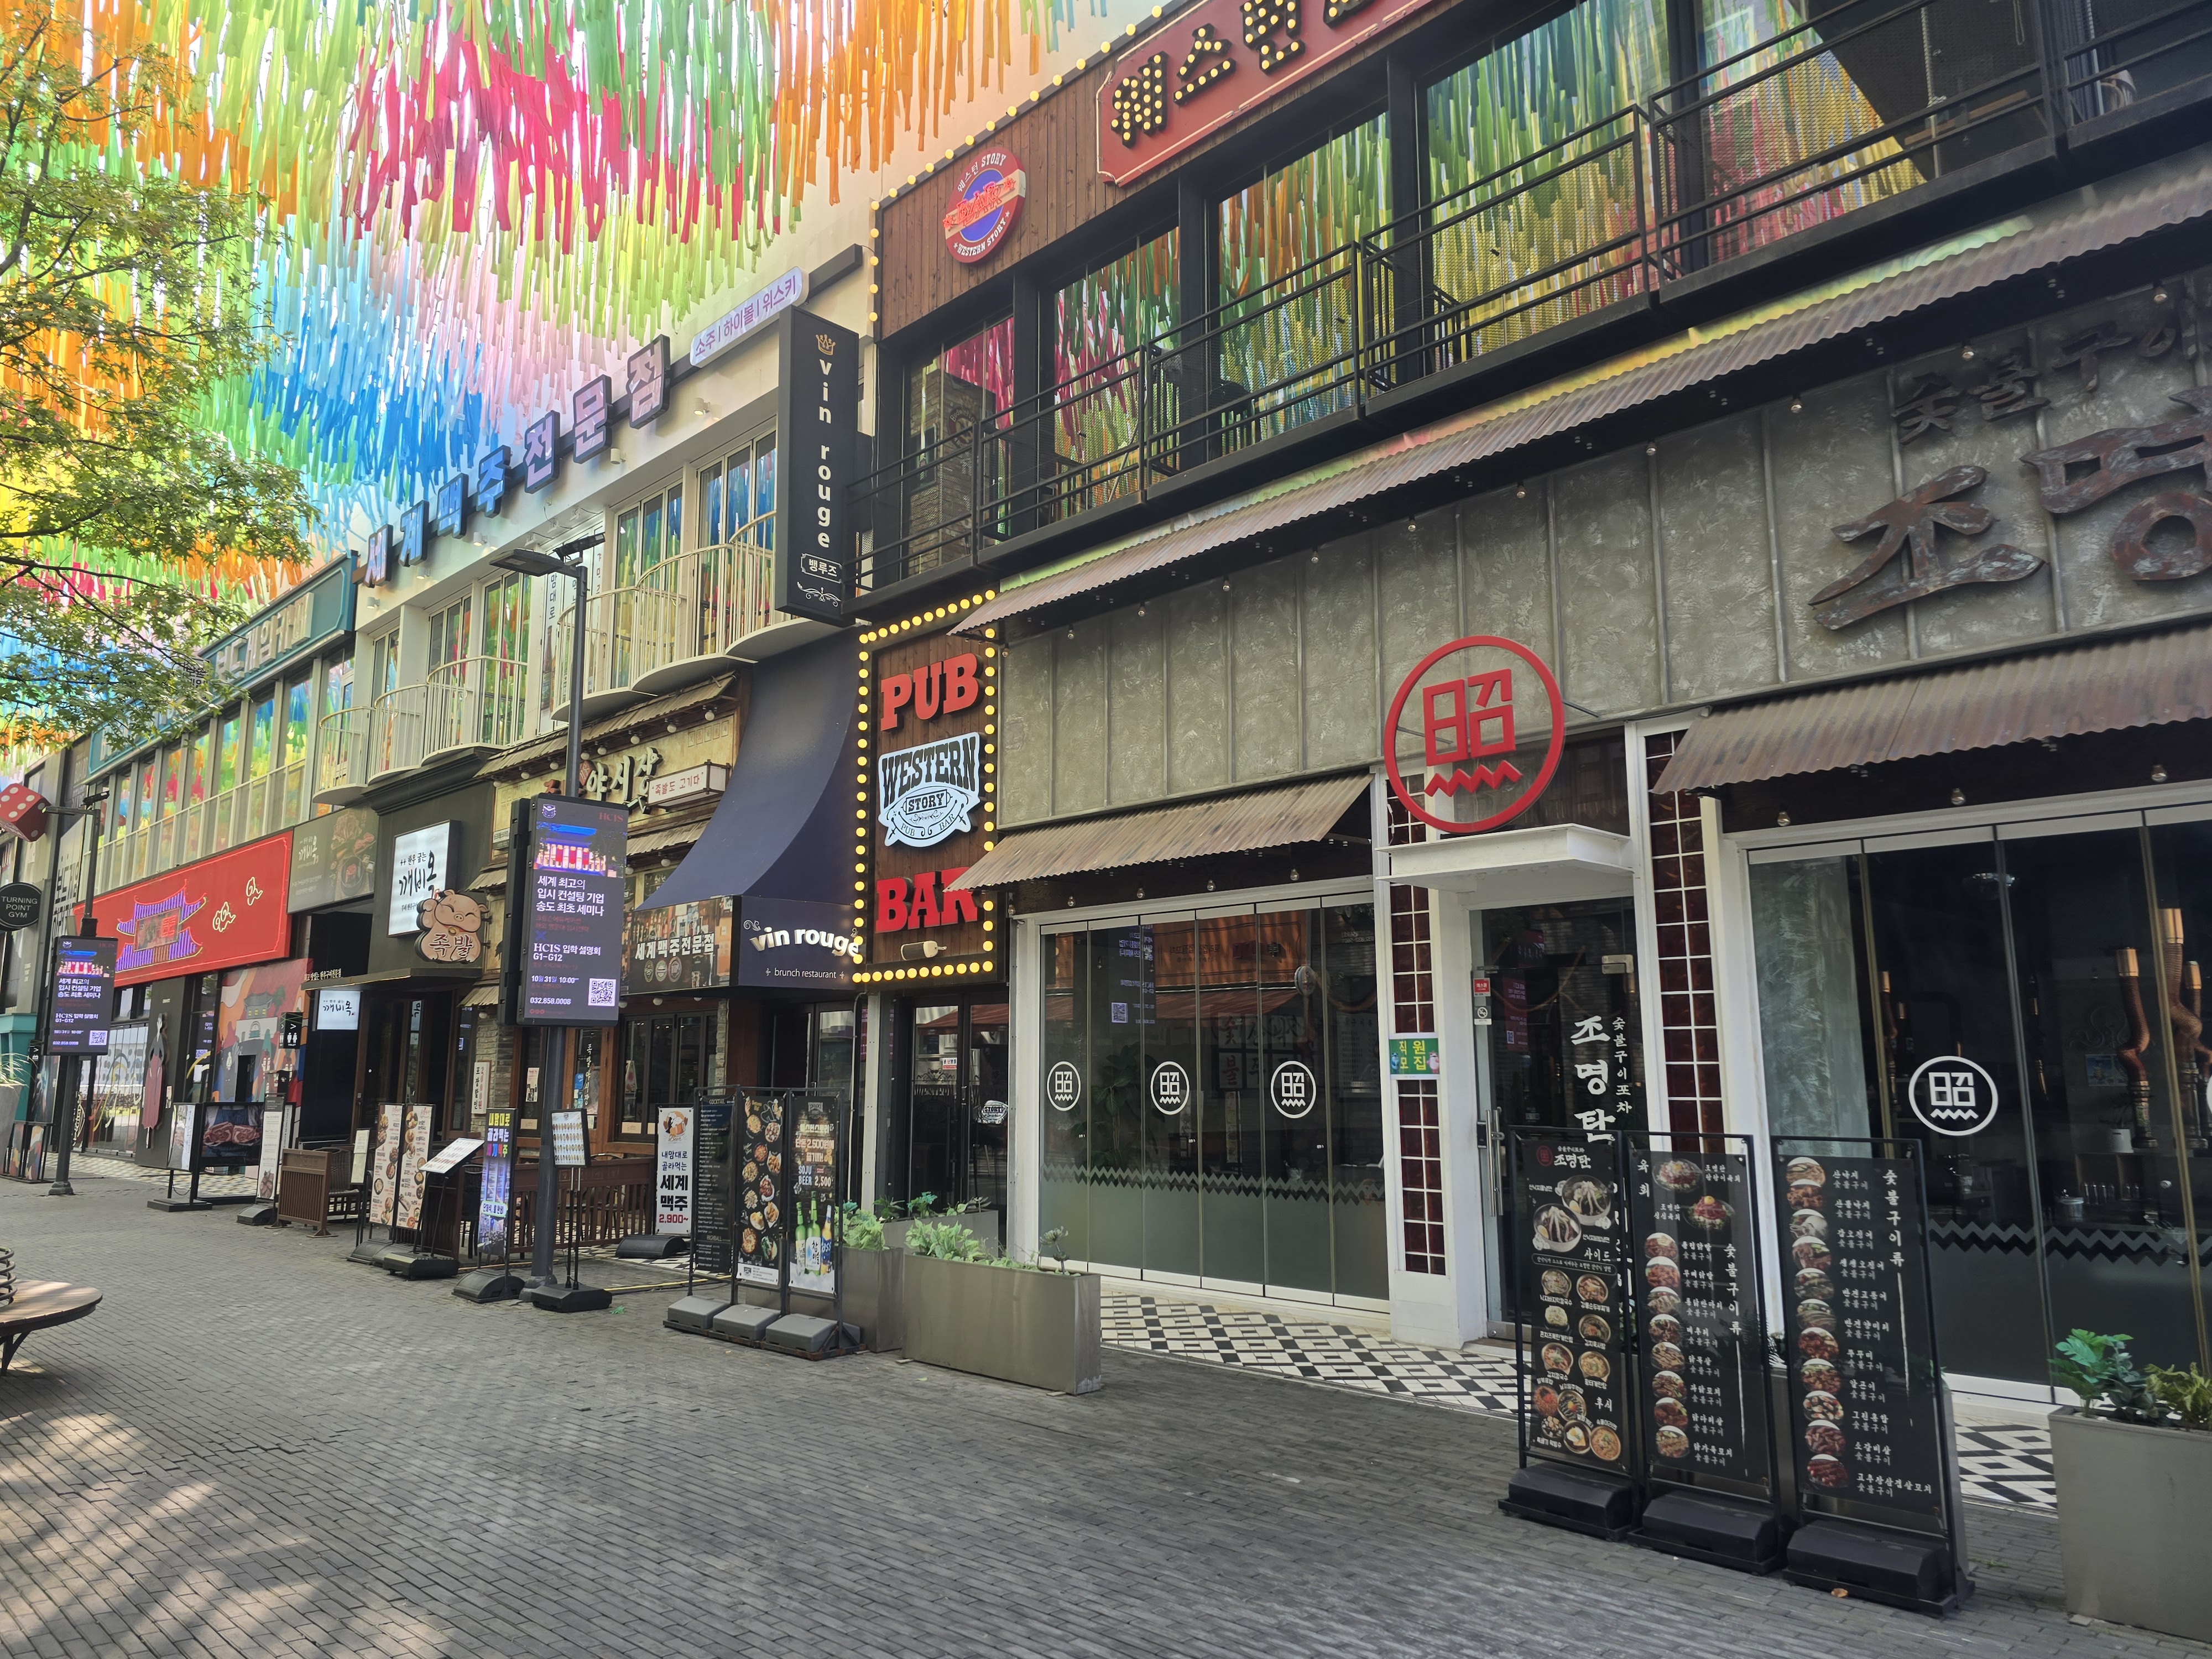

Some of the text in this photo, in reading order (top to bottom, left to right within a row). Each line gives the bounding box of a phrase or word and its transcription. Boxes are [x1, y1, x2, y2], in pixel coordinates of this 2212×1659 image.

[1110, 0, 1373, 148] 웨스턴
[958, 153, 1006, 192] 웨스턴 STORY
[956, 181, 999, 225] BAR
[957, 218, 1006, 256] WESTERN STORY
[696, 280, 797, 357] 소주 하이볼 위스키
[362, 334, 670, 588] 세계맥주전문점
[817, 358, 831, 549] vin rouge
[808, 557, 838, 577] 뱅루즈
[880, 653, 981, 731] PUB
[881, 736, 976, 809] WESTERN
[909, 792, 945, 812] STORY
[599, 812, 623, 822] HCIS
[901, 813, 955, 836] PUB BAR
[408, 854, 416, 865] 한우
[418, 852, 427, 863] 굽는
[538, 875, 585, 890] 세계 최고의
[1, 896, 38, 904] TURNING
[538, 888, 604, 904] 입시 컨설팅 기업
[875, 867, 979, 933] BAR
[536, 901, 604, 916] 송도 최초 세미나
[429, 933, 475, 957] 족발
[534, 943, 601, 956] HCIS 입학 설명회
[635, 933, 714, 961] 세계맥주전문점
[749, 926, 862, 958] vin rouge
[533, 953, 563, 962] G1-G12
[774, 967, 837, 980] brunch restaurant
[323, 1000, 352, 1016] 깨비옥
[1612, 1017, 1633, 1114] 숯불구이포차
[584, 1044, 592, 1105] 족발야시장
[1571, 1015, 1616, 1143] 조명탄
[487, 1128, 510, 1142] 골라먹는
[661, 1150, 688, 1159] 내맘대로
[1553, 1153, 1592, 1169] 조명탄
[661, 1162, 687, 1171] 골라먹는
[798, 1165, 812, 1175] SOJU
[1832, 1169, 1859, 1180] 산낙지
[660, 1175, 688, 1191] 세계
[798, 1176, 812, 1186] BEER
[1637, 1159, 1651, 1197] 육회
[660, 1195, 688, 1212] 맥주
[1882, 1169, 1905, 1267] 숯불구이류
[1584, 1247, 1611, 1261] 사이드
[1723, 1243, 1742, 1336] 숯불구이류
[1594, 1396, 1613, 1412] 후식
[1851, 1410, 1888, 1424] 그린홍합
[1854, 1441, 1891, 1455] 소갈비살
